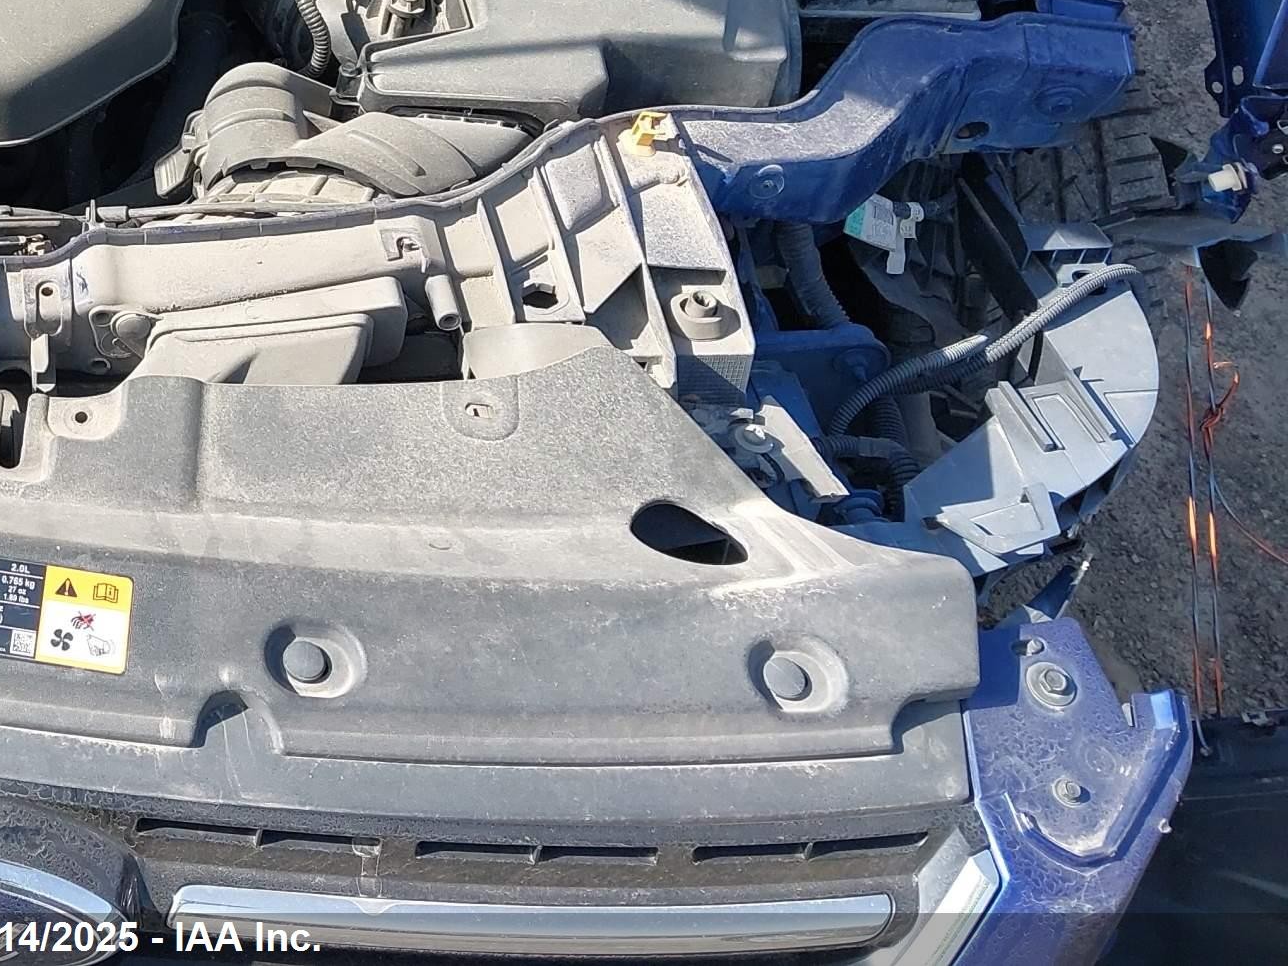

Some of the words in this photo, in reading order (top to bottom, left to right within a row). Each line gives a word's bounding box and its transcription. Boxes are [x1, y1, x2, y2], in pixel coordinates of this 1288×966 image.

[10, 563, 31, 574] 2.0L
[1, 575, 23, 587] 0.765
[25, 578, 36, 590] kg
[7, 585, 17, 593] 27
